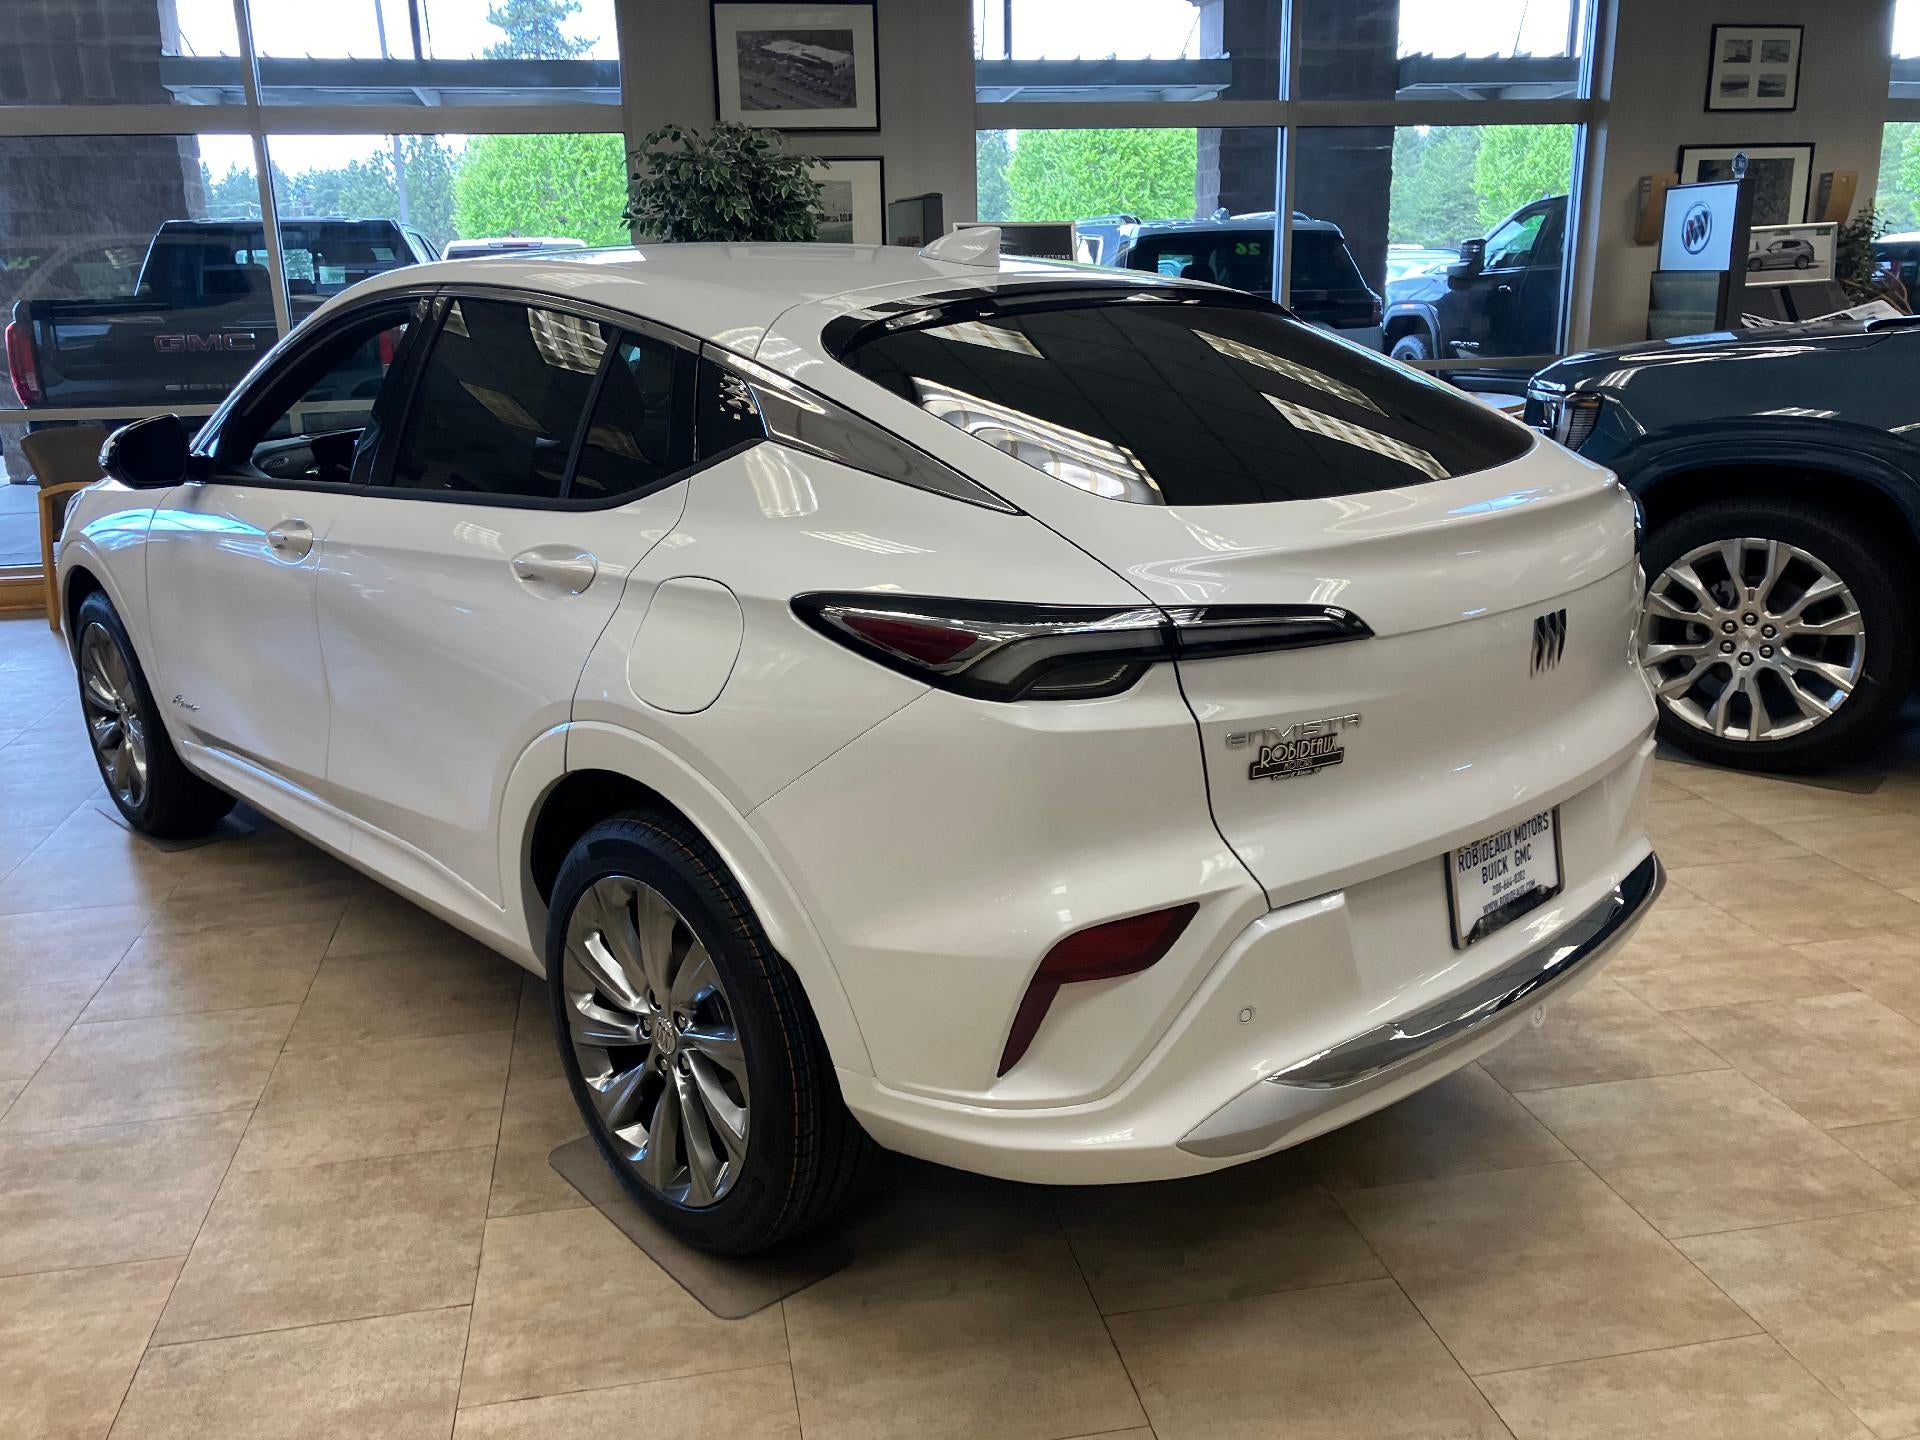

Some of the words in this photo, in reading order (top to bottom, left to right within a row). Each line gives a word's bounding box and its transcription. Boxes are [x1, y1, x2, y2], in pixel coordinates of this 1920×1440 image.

[153, 333, 256, 353] GMC
[1225, 713, 1362, 748] ENVISTA
[1260, 736, 1338, 769] ROBIDEAUX
[1283, 758, 1313, 771] MOTORS
[1457, 830, 1513, 874] ROBIDEAUX
[1514, 811, 1549, 846] MOTORS
[1481, 855, 1509, 884] BUICK
[1514, 843, 1532, 867] GMC
